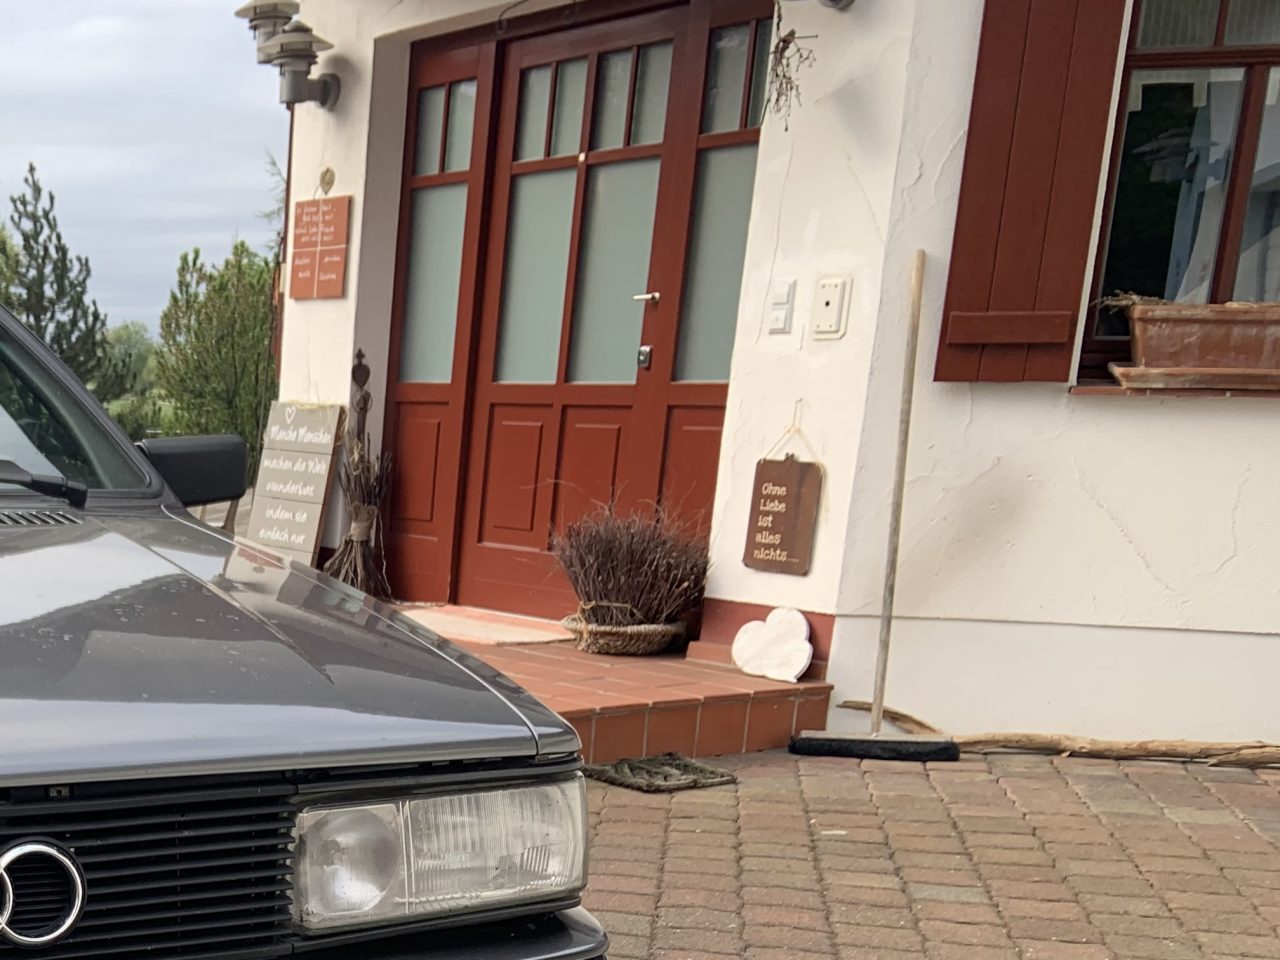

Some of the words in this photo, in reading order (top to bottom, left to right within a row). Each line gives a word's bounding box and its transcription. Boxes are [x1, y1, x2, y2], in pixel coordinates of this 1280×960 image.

[297, 425, 331, 444] Menschen
[263, 456, 292, 471] machen
[762, 482, 787, 496] Ohne
[759, 499, 786, 513] Liebe
[265, 505, 293, 520] indem
[294, 511, 307, 522] sie
[757, 514, 773, 528] ist
[259, 526, 289, 542] einfach
[290, 533, 306, 544] nur
[754, 532, 782, 545] alles
